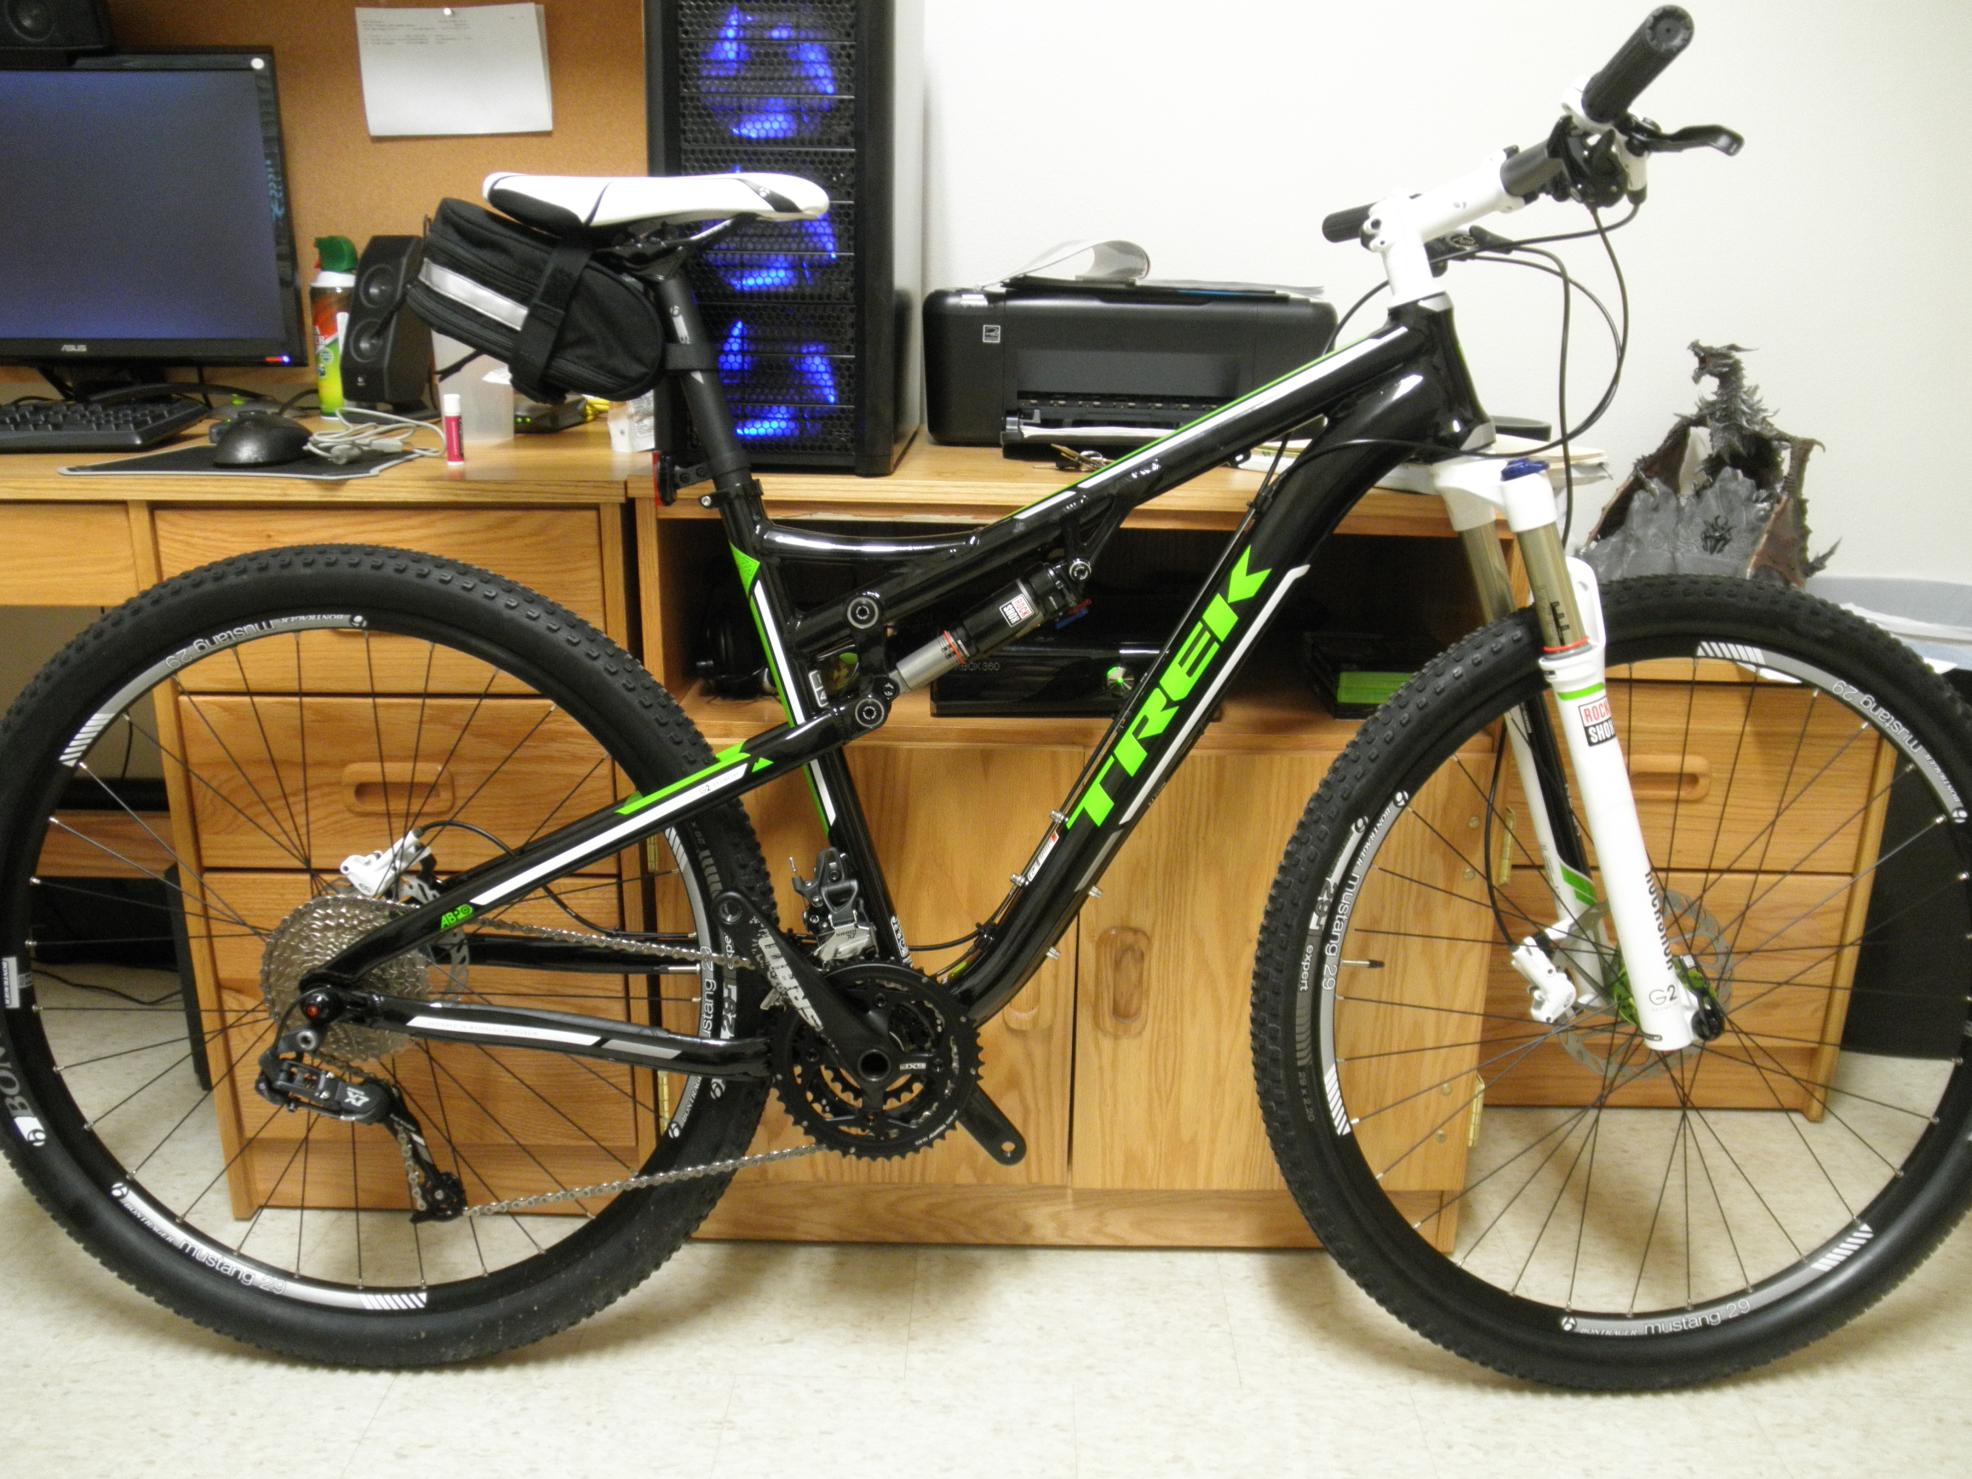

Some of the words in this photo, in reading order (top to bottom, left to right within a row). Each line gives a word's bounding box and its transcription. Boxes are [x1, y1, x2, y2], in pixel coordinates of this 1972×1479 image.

[61, 344, 87, 352] ASUS
[193, 620, 275, 650] mustang
[165, 649, 192, 669] 29
[1066, 545, 1272, 830] TREK
[1832, 680, 1858, 701] 29
[1860, 694, 1923, 752] mustang
[1325, 872, 1361, 957] mustang
[1299, 944, 1314, 991] expert
[1321, 964, 1338, 990] 29
[1649, 984, 1678, 1006] G2
[180, 1239, 256, 1286] mustang
[259, 1278, 287, 1295] 29
[1644, 1310, 1722, 1336] mustang
[1726, 1299, 1750, 1318] 29
